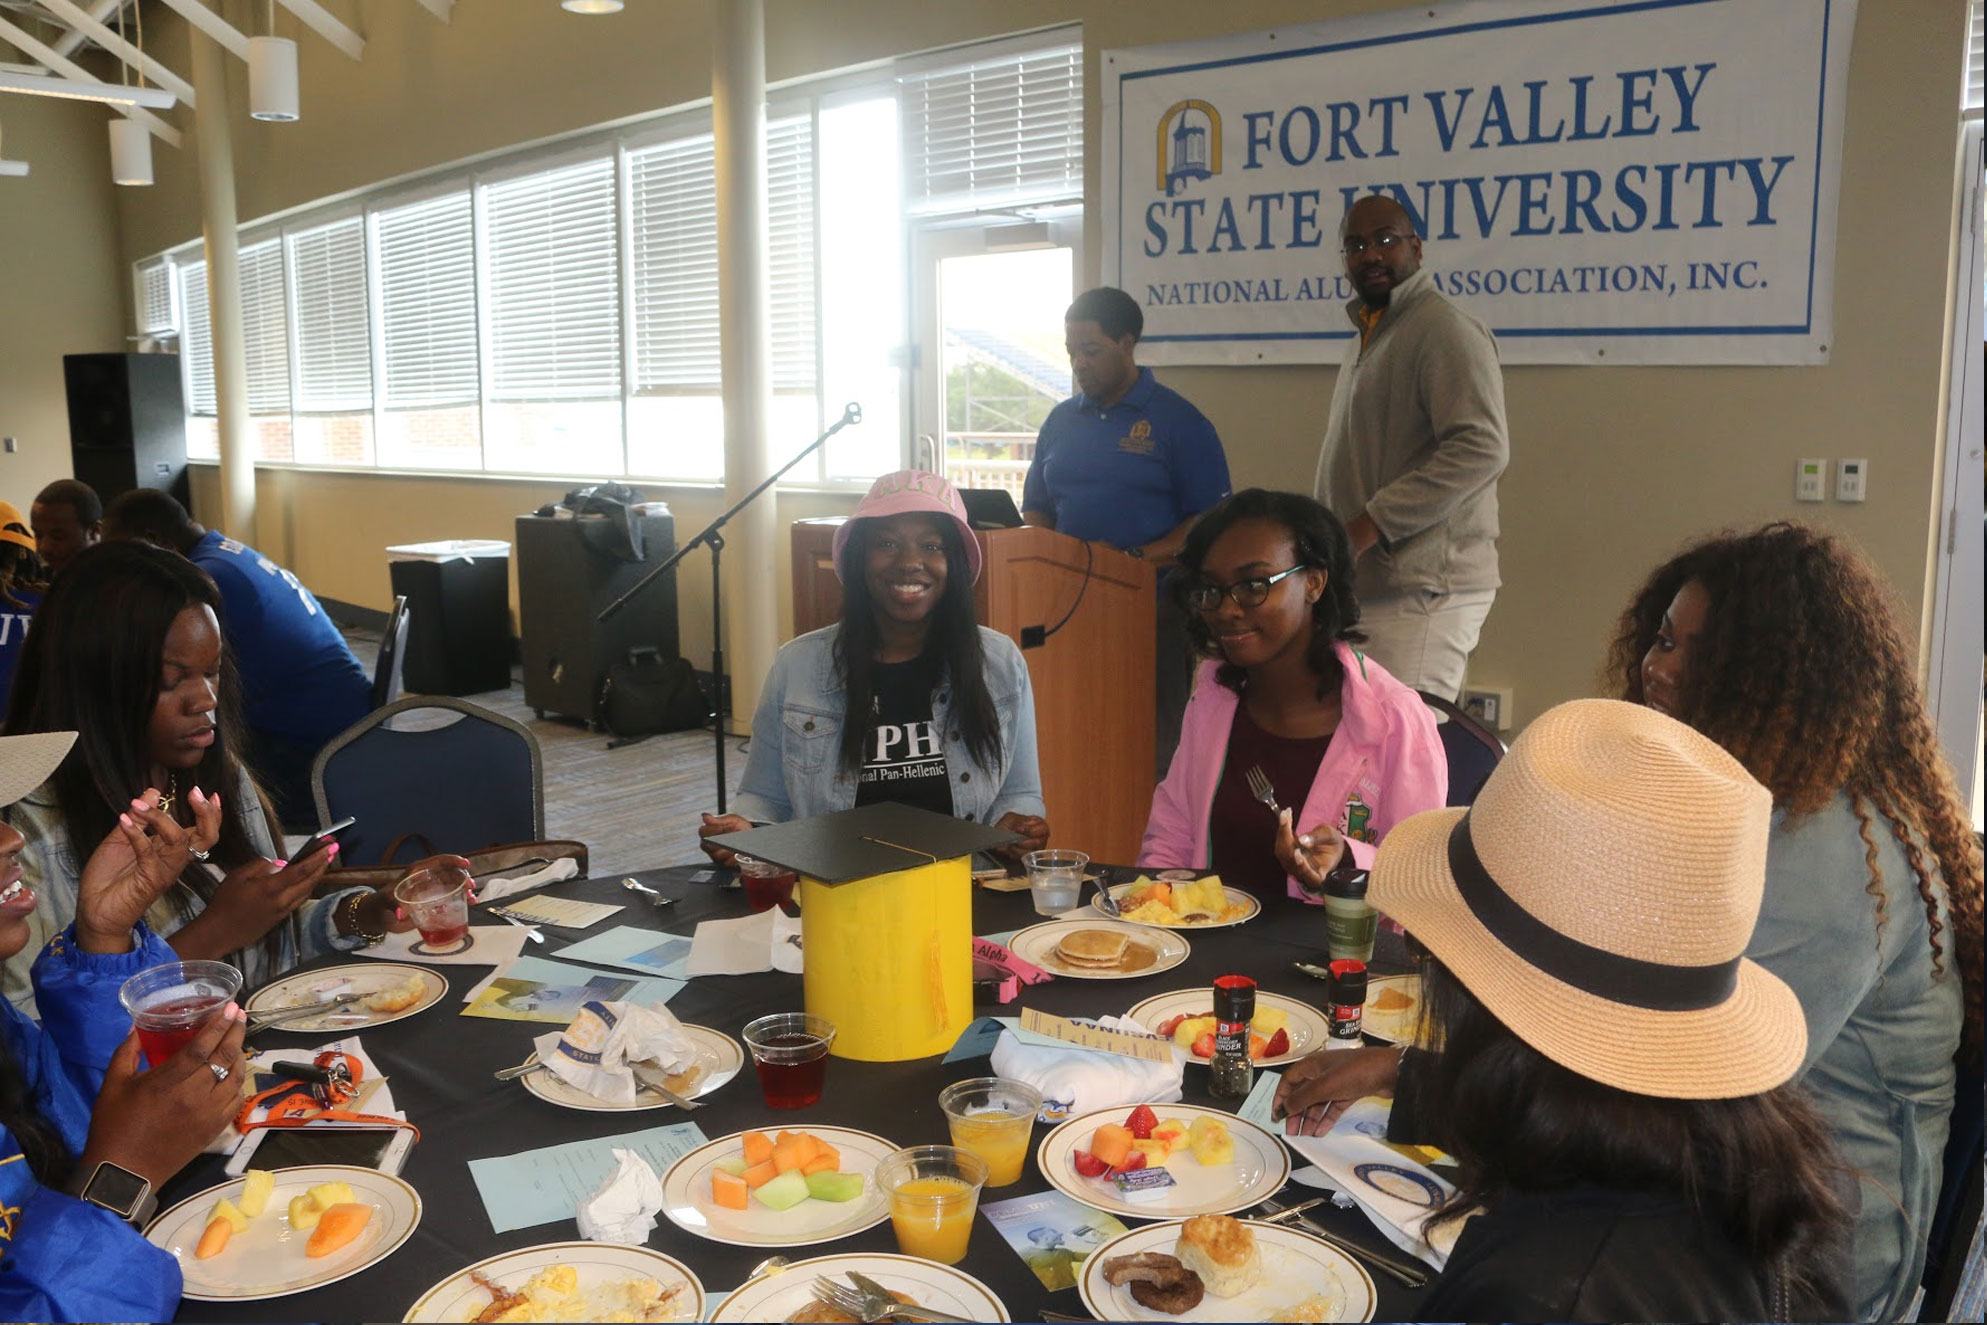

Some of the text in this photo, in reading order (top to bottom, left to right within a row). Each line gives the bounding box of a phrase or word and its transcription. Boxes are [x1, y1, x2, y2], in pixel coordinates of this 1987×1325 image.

[1242, 62, 1717, 170] FORT VALLEY
[1144, 189, 1323, 258] STATE
[1146, 278, 1290, 307] NATIONAL
[1295, 276, 1353, 301] ALU
[1687, 261, 1768, 290] INC.
[880, 762, 946, 781] Pan-Hellenic
[977, 944, 1009, 963] Alpha
